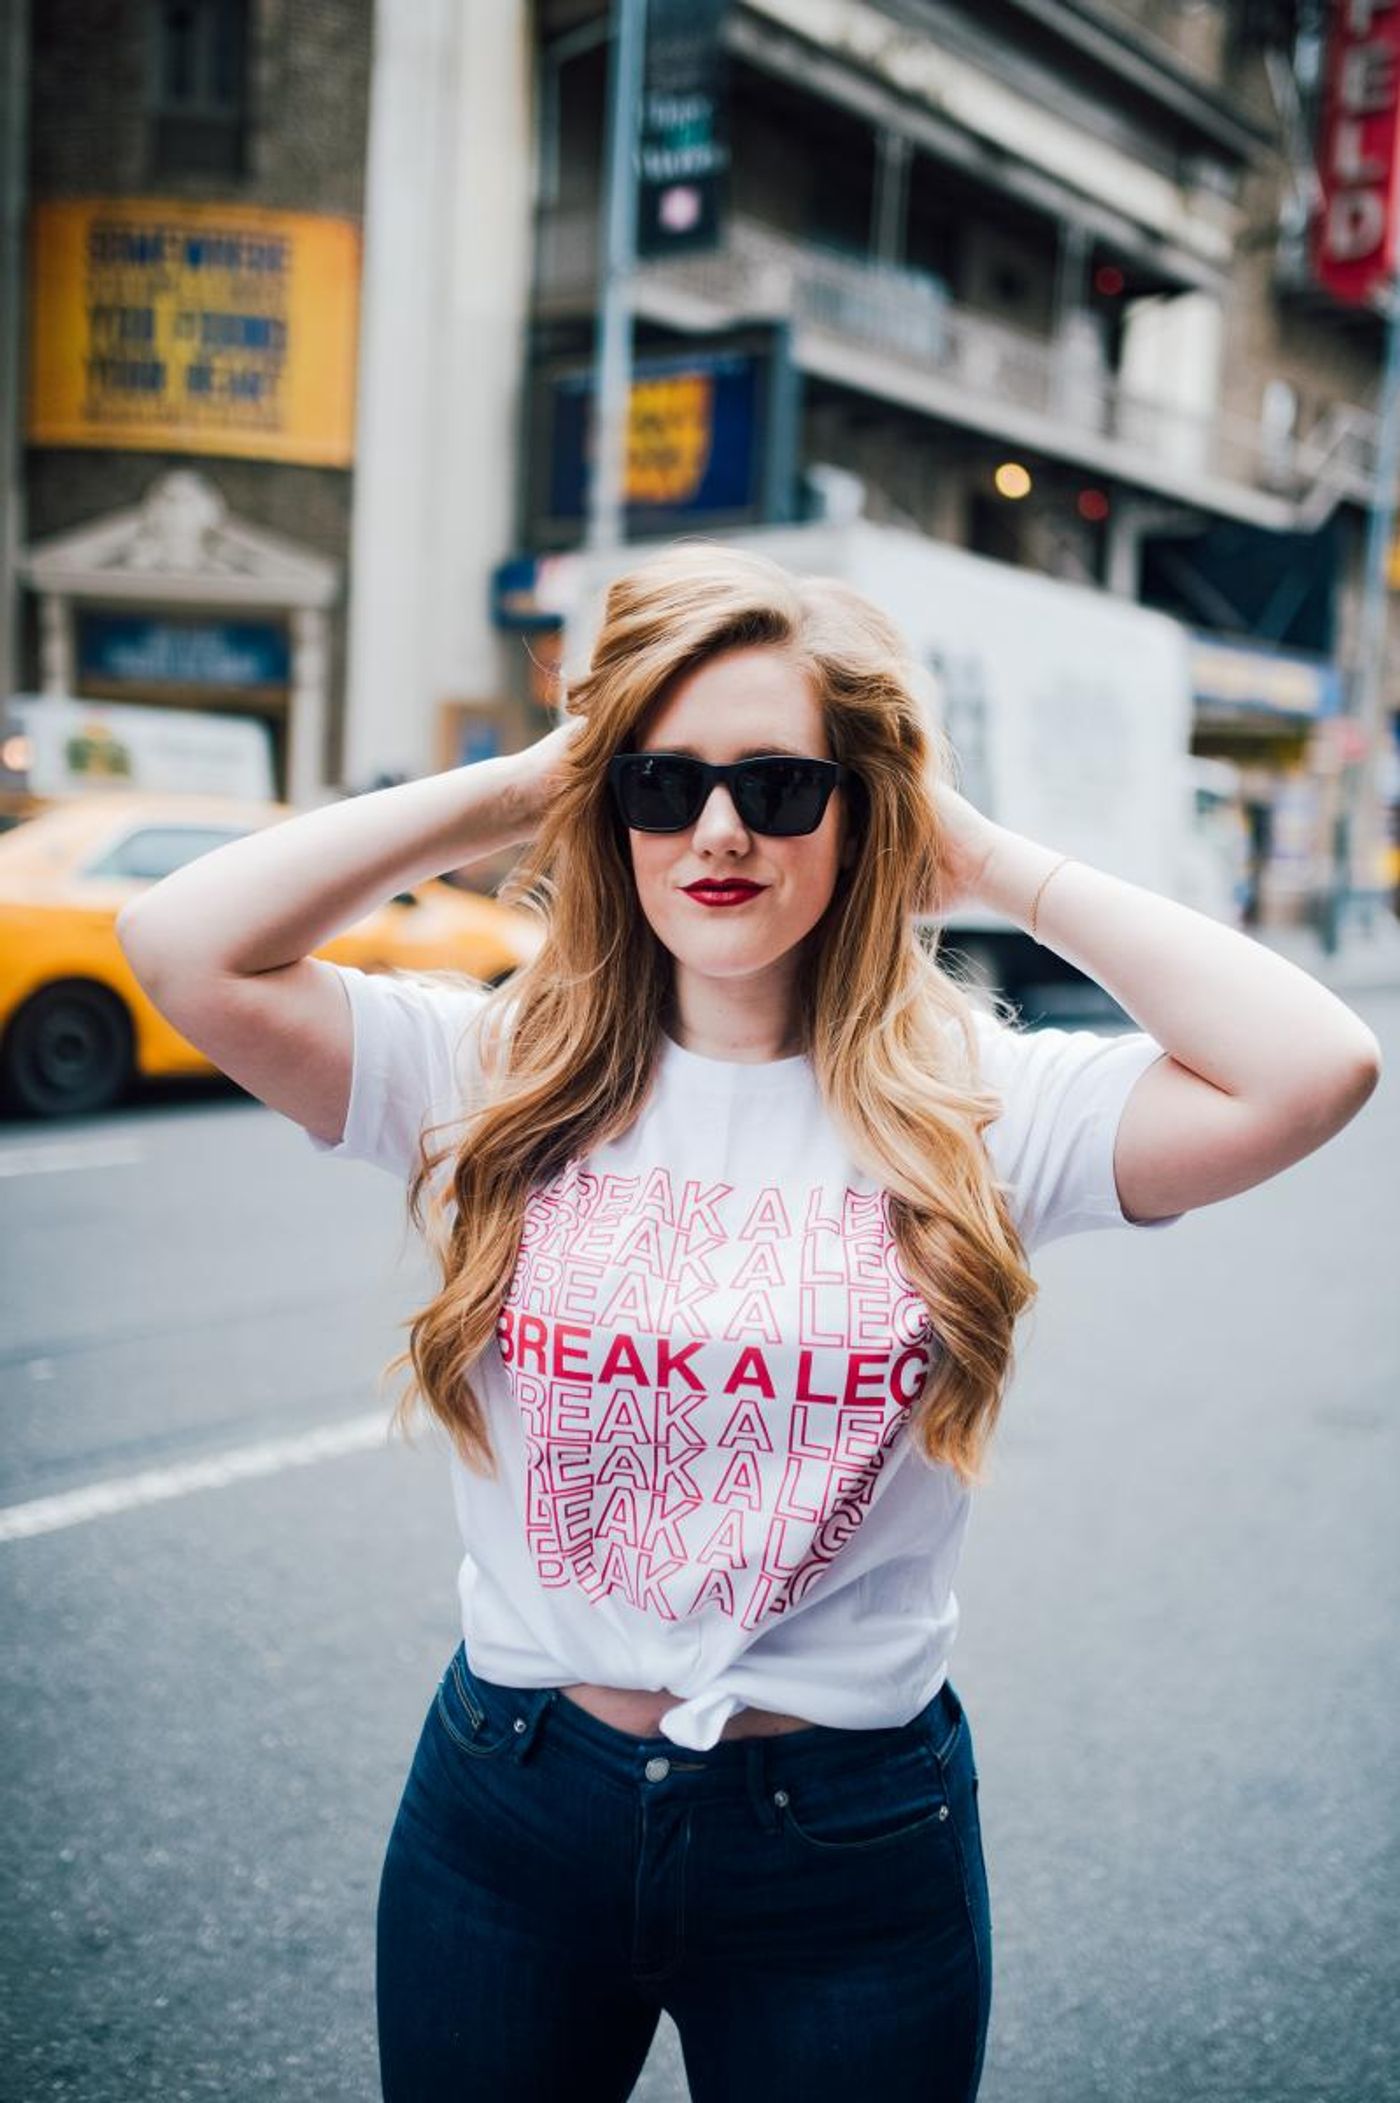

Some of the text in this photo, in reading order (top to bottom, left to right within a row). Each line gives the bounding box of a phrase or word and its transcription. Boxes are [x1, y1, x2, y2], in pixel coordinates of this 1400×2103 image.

[738, 1187, 792, 1241] A
[730, 1242, 786, 1289] A
[723, 1289, 782, 1344] A
[499, 1309, 928, 1408] BREAK A LEG
[502, 1365, 708, 1447] REAK
[718, 1400, 773, 1452] A
[714, 1450, 763, 1512] A
[702, 1510, 747, 1569] A
[688, 1568, 734, 1617] A
